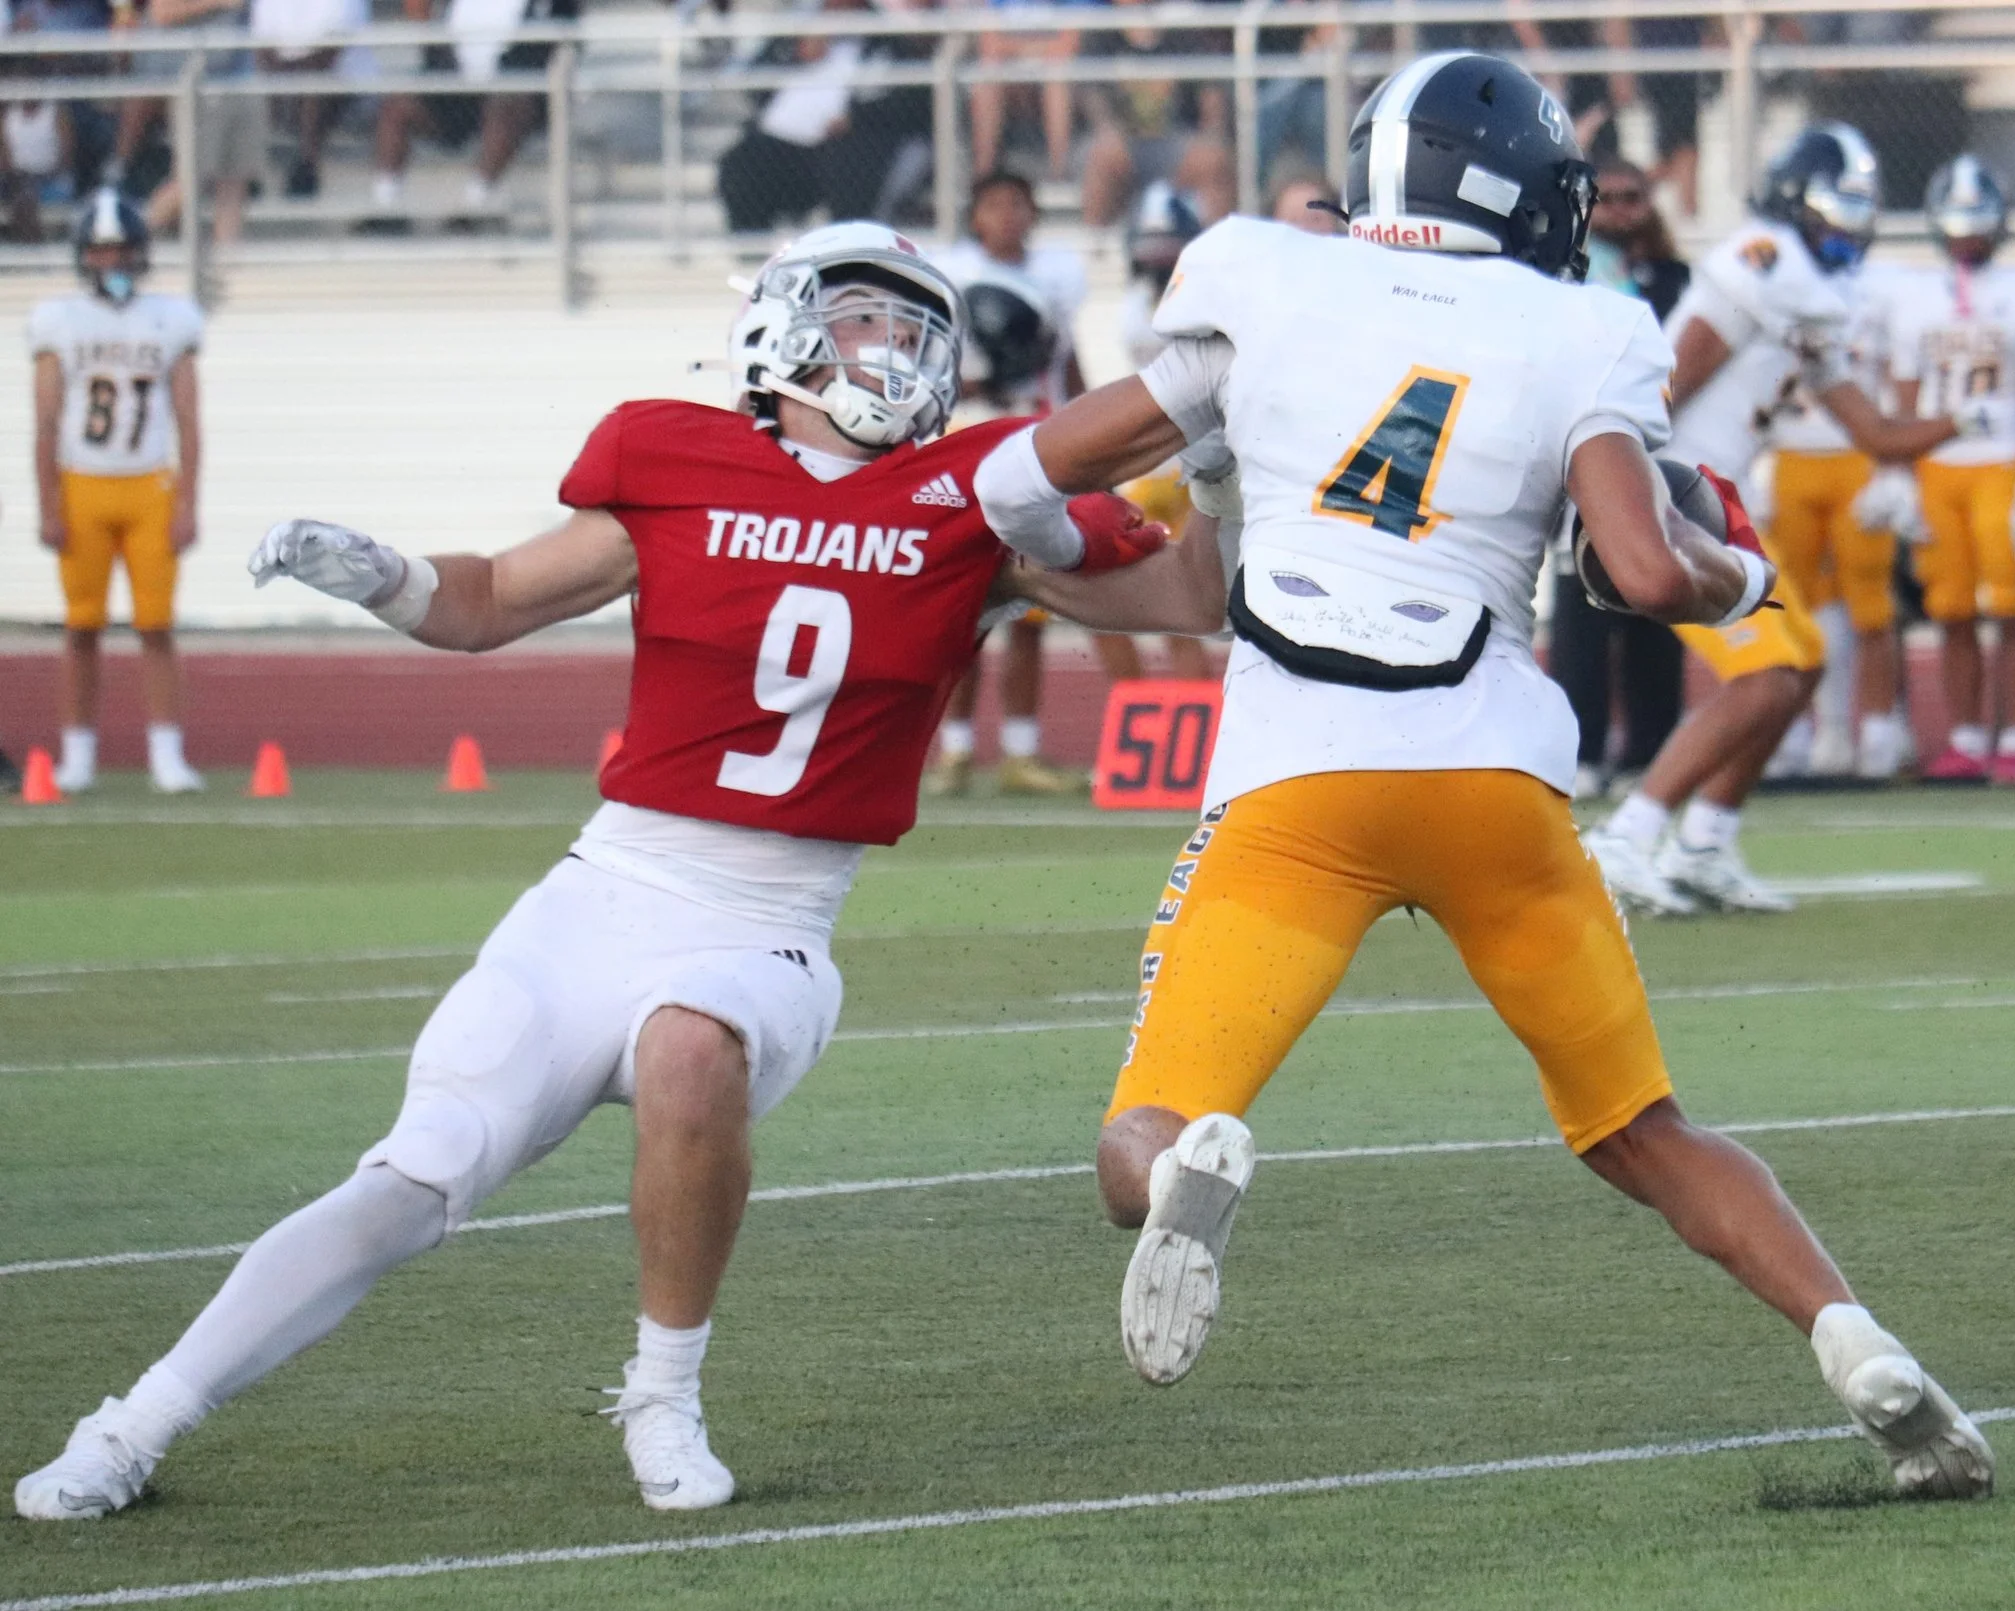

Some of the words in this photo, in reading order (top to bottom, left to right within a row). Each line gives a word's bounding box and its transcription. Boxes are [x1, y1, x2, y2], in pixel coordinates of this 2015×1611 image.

[1391, 284, 1418, 299] WAR
[1422, 292, 1458, 306] EAGLE
[1311, 363, 1471, 544] 4
[706, 509, 929, 576] TROJANS
[911, 492, 967, 508] adidas
[716, 584, 852, 797] 9
[1109, 702, 1212, 790] 50
[1153, 801, 1230, 926] EAGL
